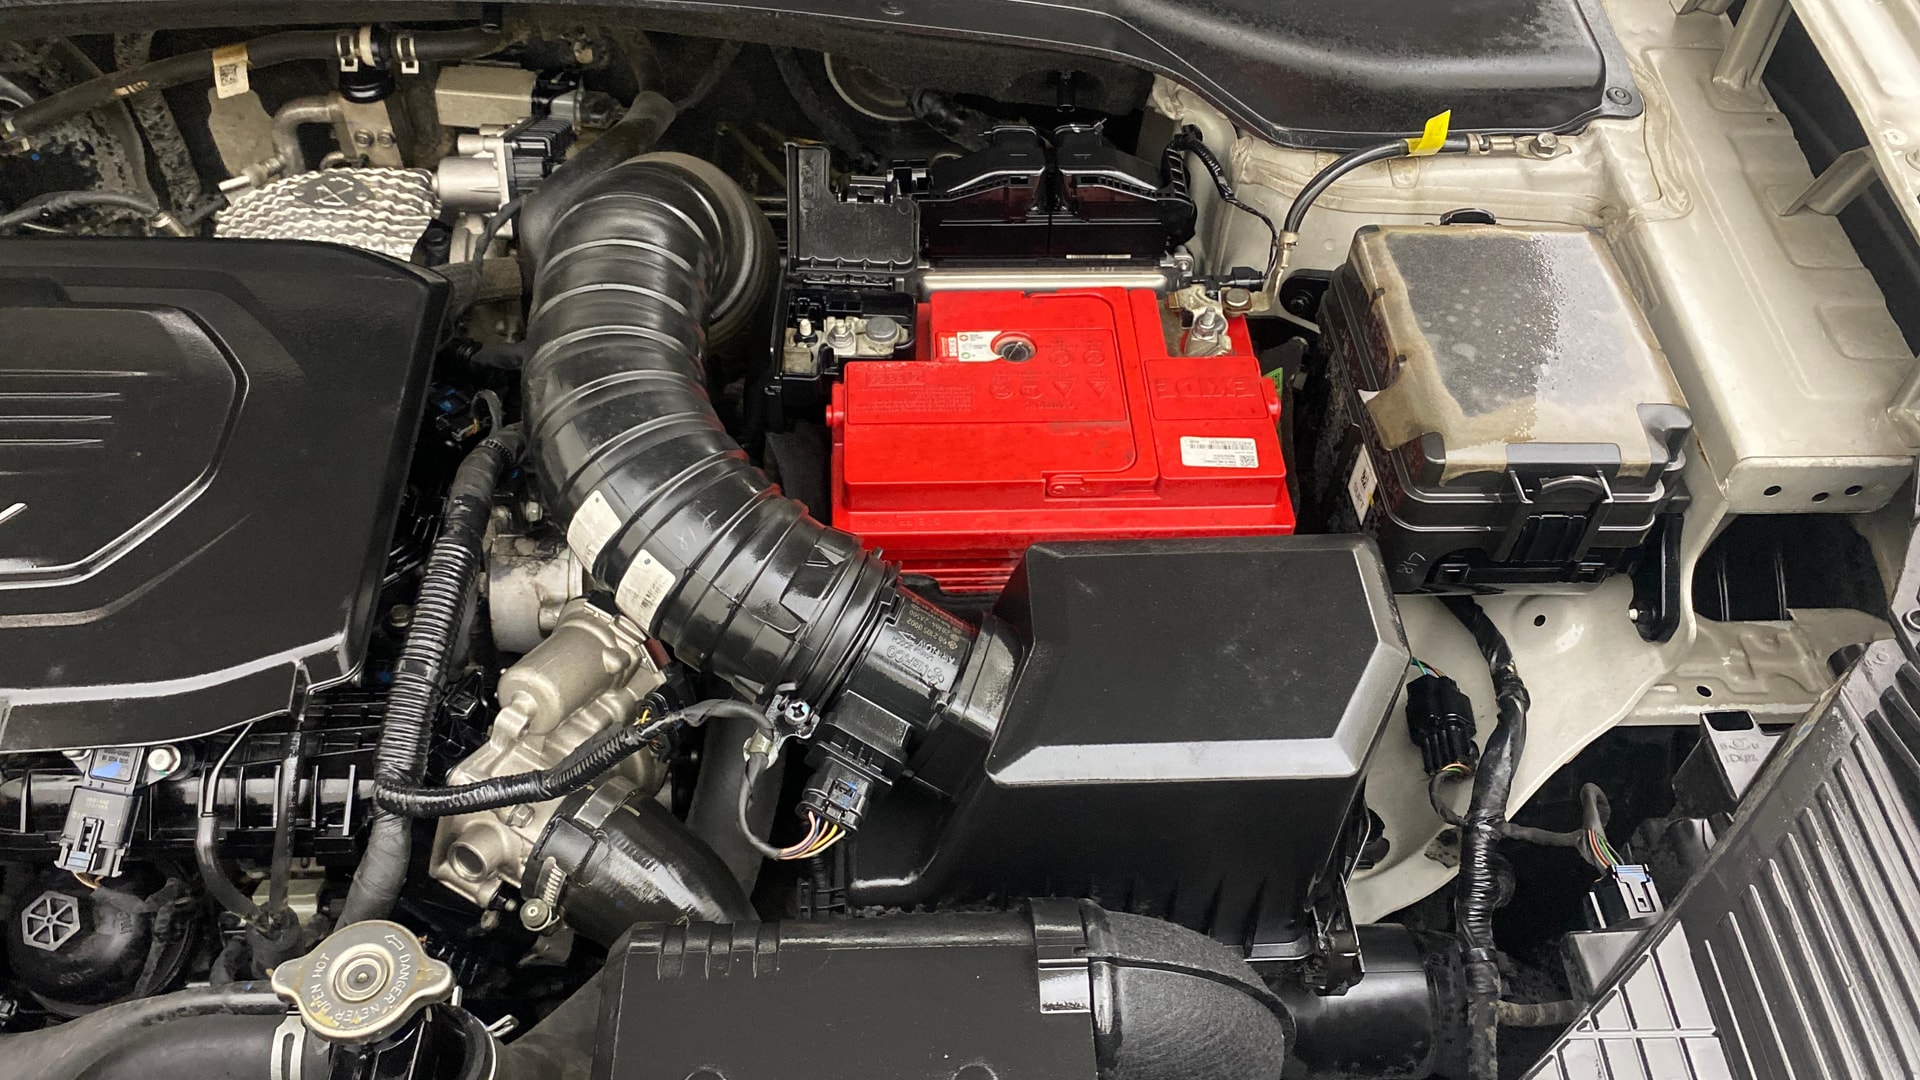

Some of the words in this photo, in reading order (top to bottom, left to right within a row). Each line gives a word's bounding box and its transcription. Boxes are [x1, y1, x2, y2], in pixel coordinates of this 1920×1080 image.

[1155, 379, 1257, 398] EXIDE
[312, 953, 330, 978] HOT
[384, 954, 411, 1007] DANGER
[310, 983, 332, 1012] OPEN
[335, 1004, 380, 1022] NEVER
